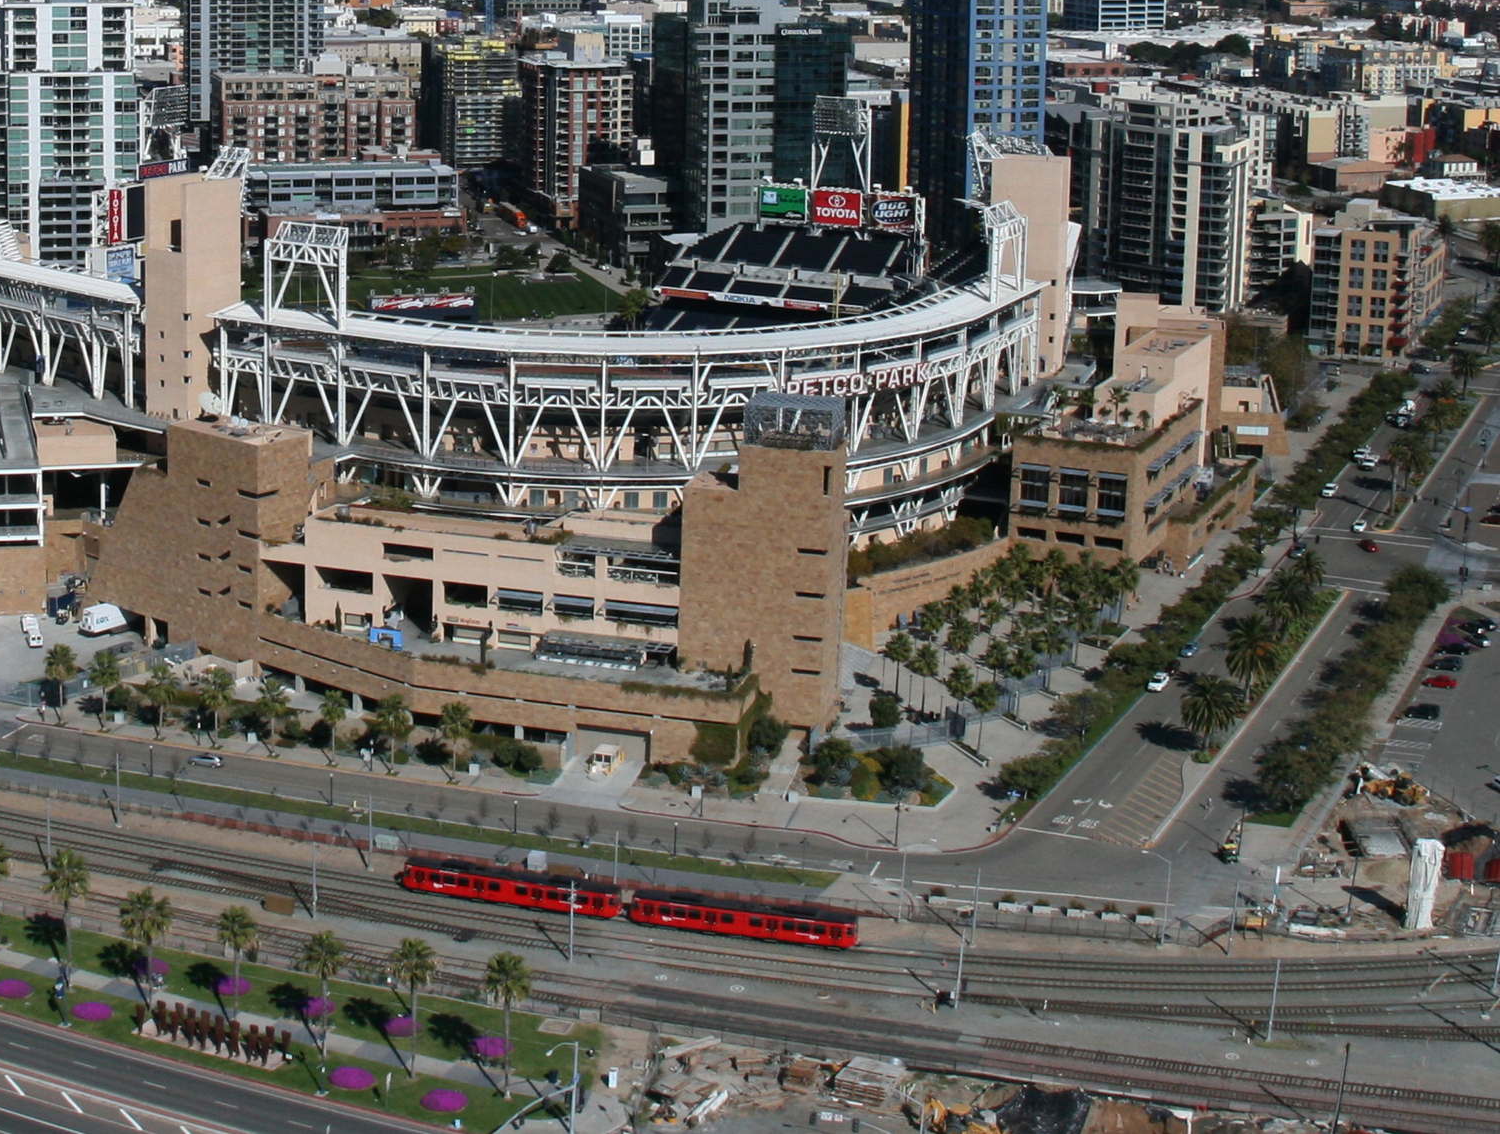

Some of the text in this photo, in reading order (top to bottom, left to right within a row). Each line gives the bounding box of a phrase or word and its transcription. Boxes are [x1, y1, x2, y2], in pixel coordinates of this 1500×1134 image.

[168, 160, 187, 174] PARK
[878, 201, 908, 210] BUD
[816, 206, 858, 219] TOYOTA
[875, 208, 911, 218] LIGHT
[724, 294, 756, 303] NOKIA
[786, 362, 930, 397] PETCO PARK
